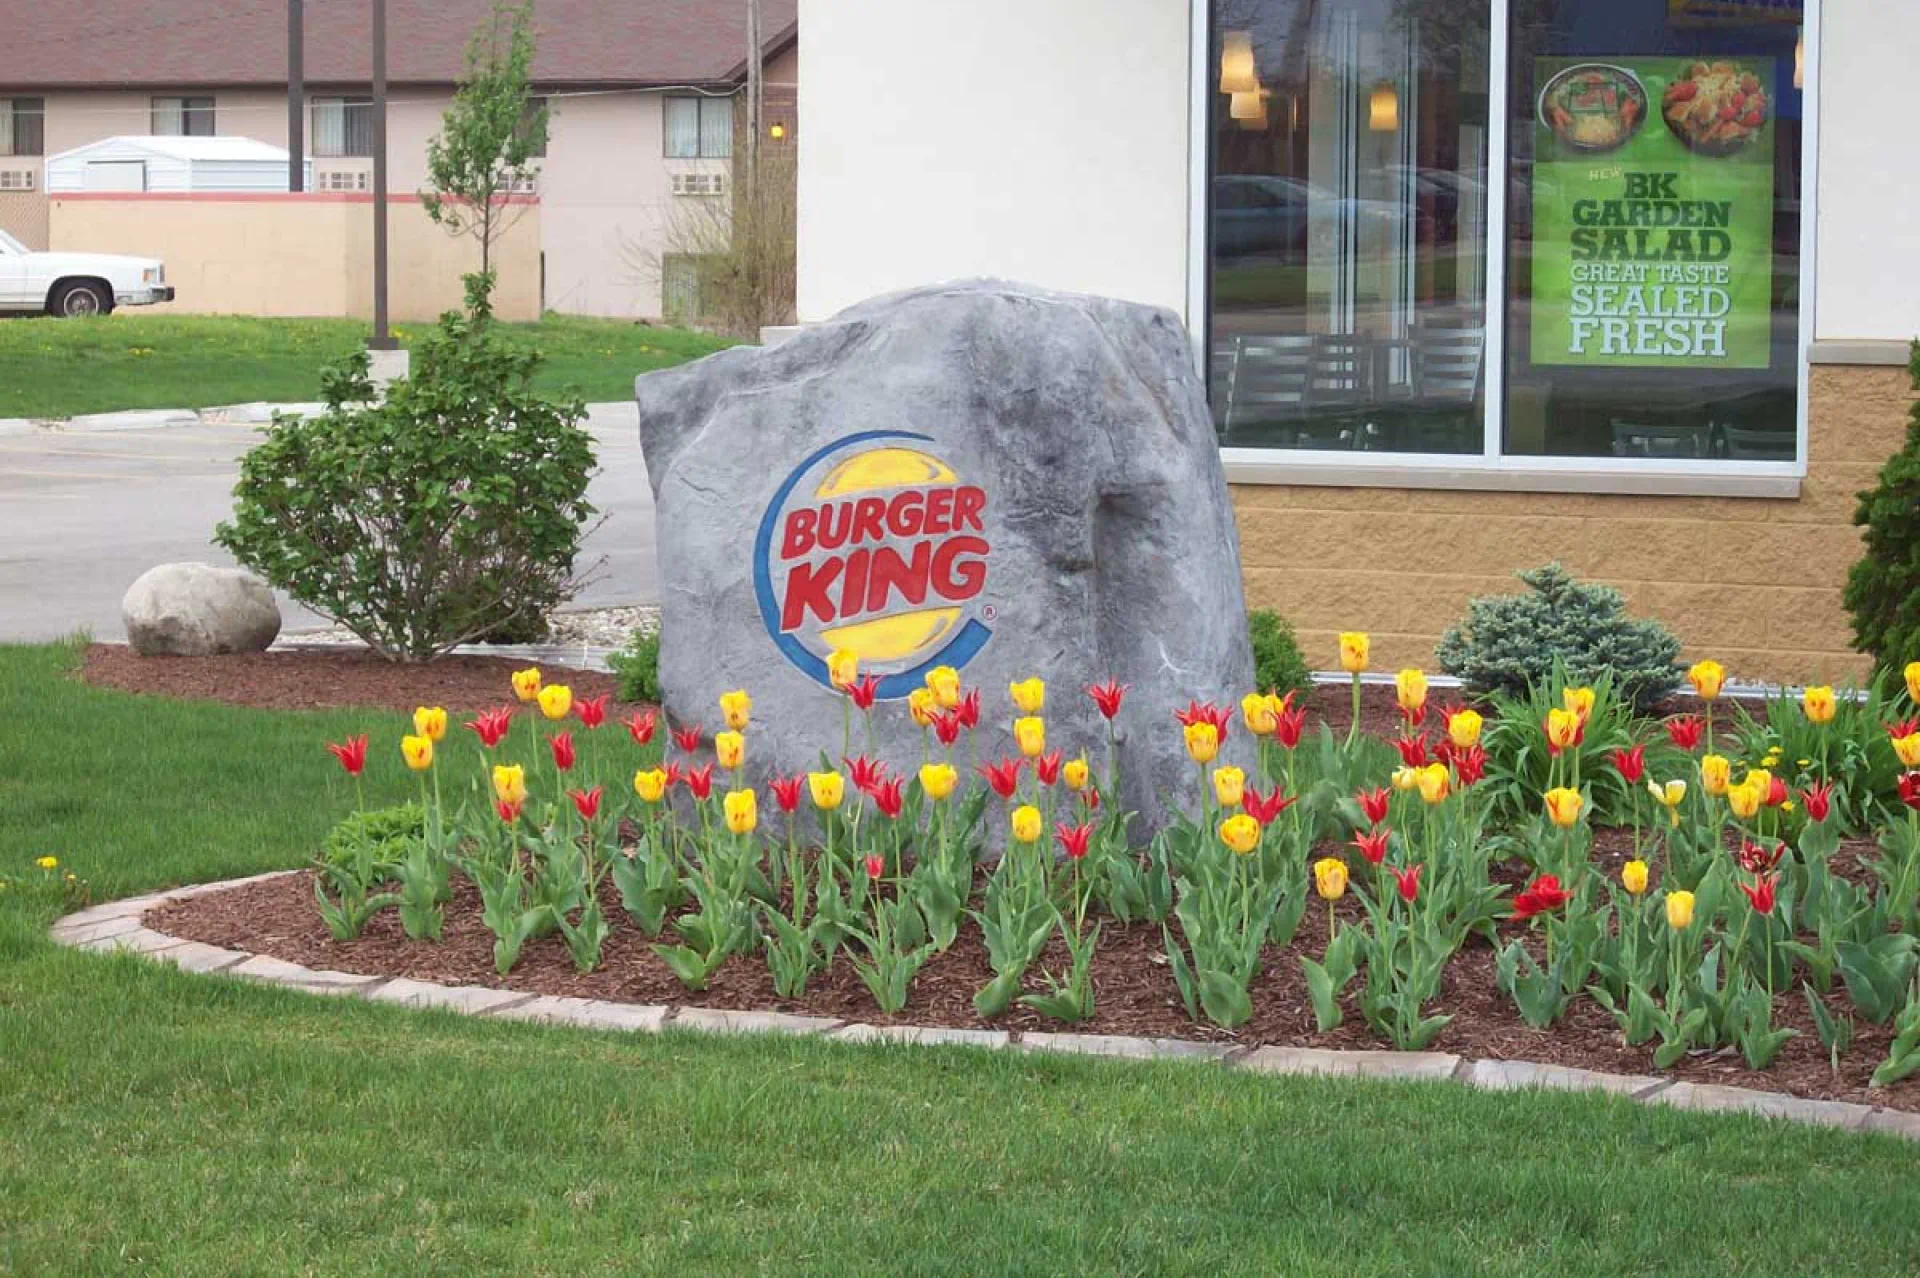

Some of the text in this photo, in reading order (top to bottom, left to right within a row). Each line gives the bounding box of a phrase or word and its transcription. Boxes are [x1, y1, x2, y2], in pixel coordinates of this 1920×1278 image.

[1624, 173, 1677, 198] BK
[1572, 200, 1731, 228] GARDEN
[1571, 228, 1731, 262] SALAD
[1572, 263, 1729, 285] GREAT TASTE
[1571, 285, 1731, 318] SEALED
[1569, 318, 1727, 356] FRESH
[781, 486, 987, 560] BURGER
[781, 535, 990, 632] KING
